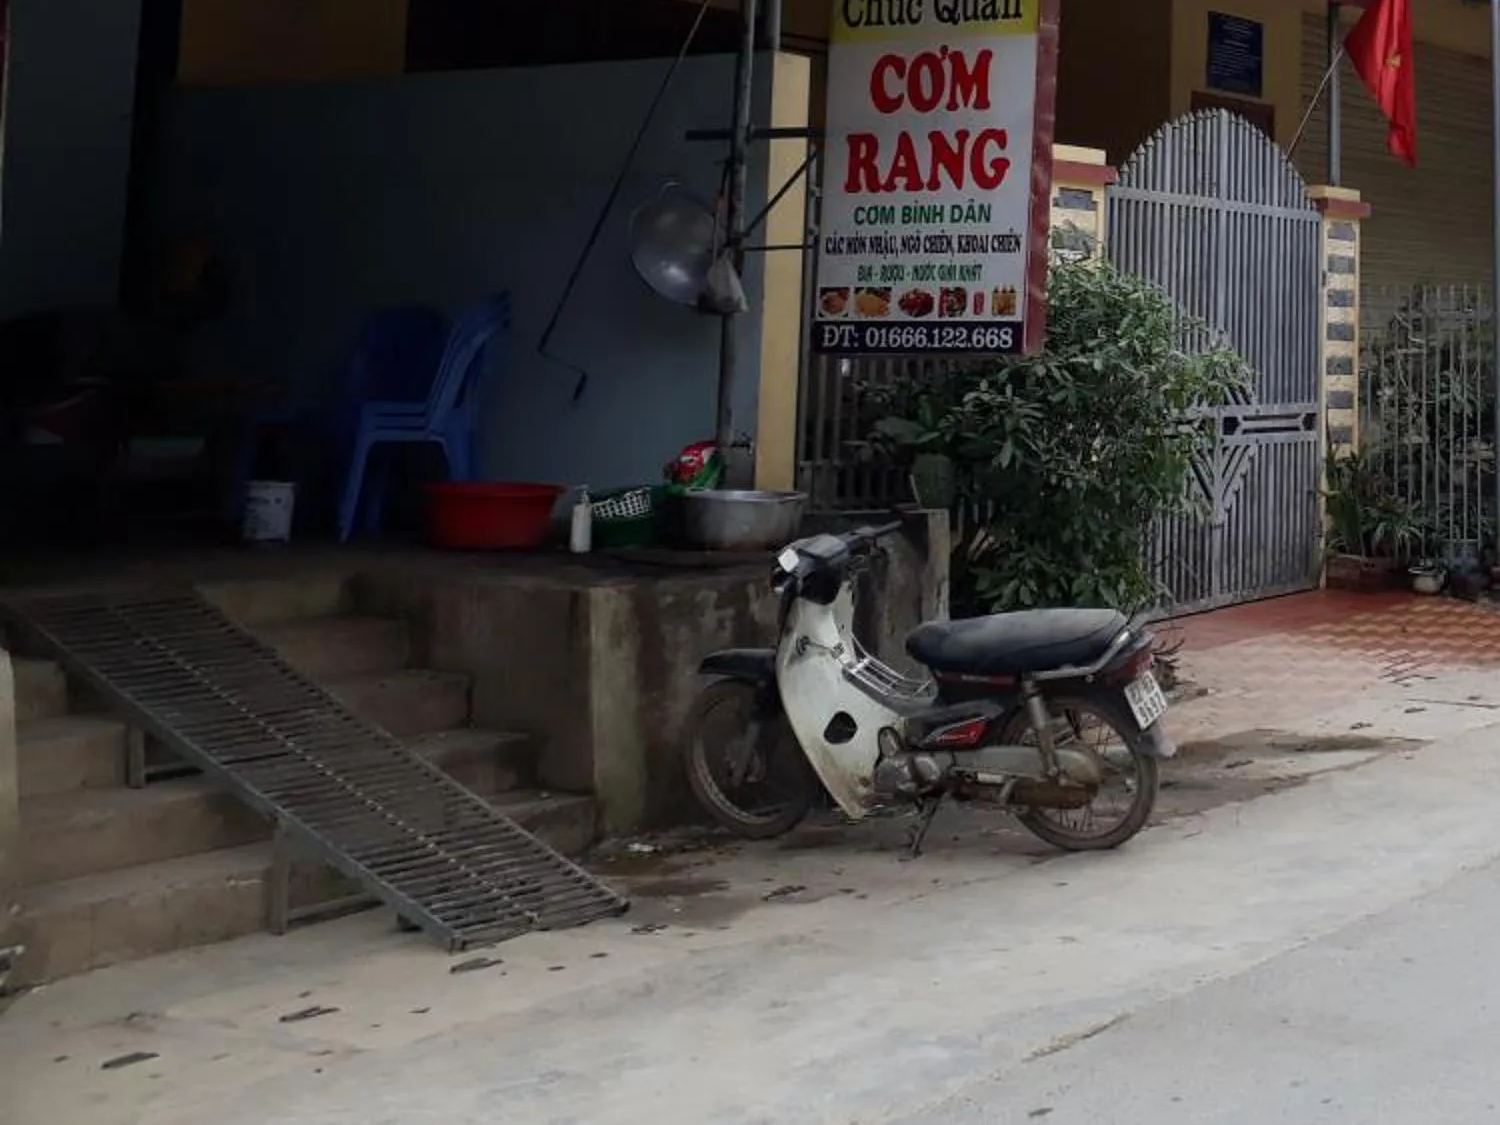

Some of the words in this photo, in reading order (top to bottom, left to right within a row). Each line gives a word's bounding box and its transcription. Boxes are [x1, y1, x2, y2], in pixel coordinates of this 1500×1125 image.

[870, 45, 993, 114] CƠM
[844, 128, 1011, 194] RANG
[853, 205, 895, 225] CƠM
[901, 200, 944, 224] BÌNH
[950, 199, 992, 223] DÂN
[822, 326, 860, 348] ĐT:
[865, 326, 1013, 349] 01666.122.668
